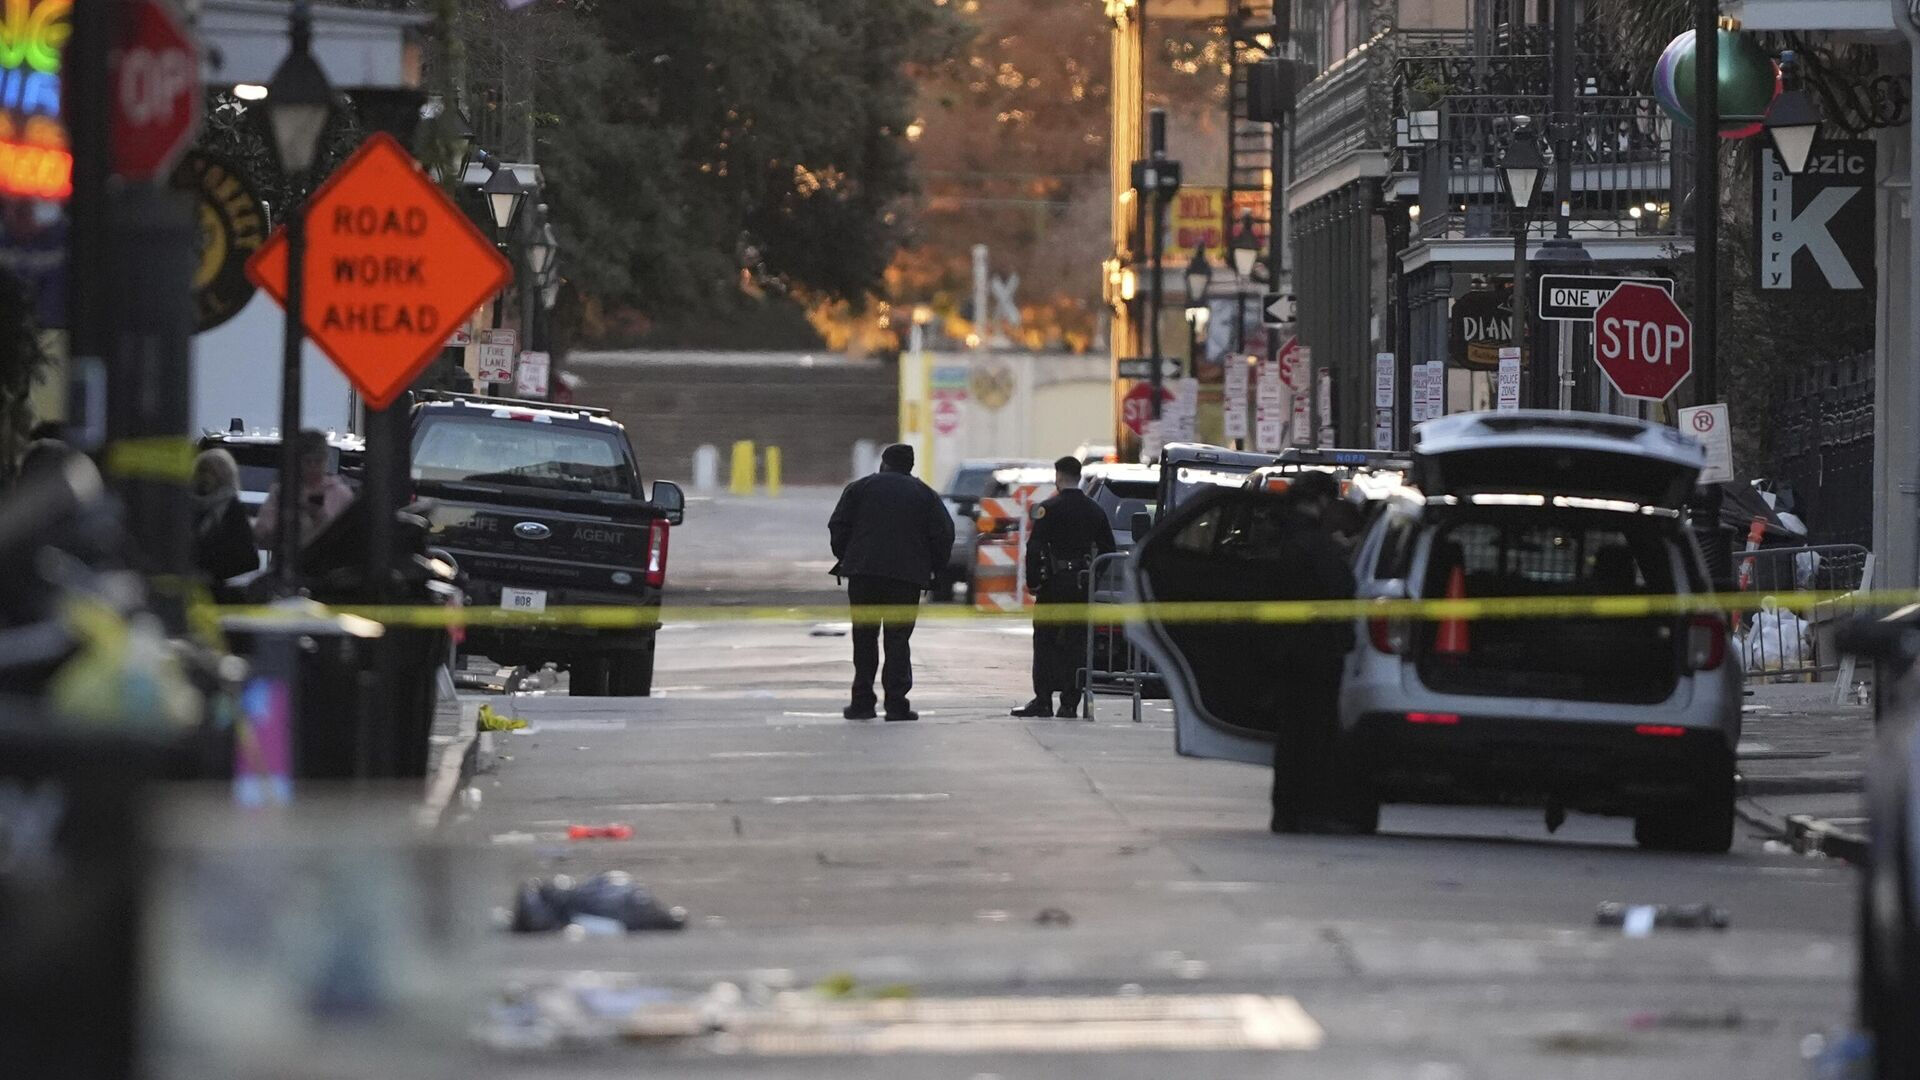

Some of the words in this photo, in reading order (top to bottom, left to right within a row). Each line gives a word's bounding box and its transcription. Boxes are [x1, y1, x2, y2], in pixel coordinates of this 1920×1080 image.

[333, 205, 428, 238] ROAD
[333, 255, 425, 287] WORK
[1555, 289, 1590, 306] ONE
[320, 303, 440, 336] AHEAD
[1463, 316, 1513, 341] DIAN
[1601, 317, 1685, 365] STOP
[485, 358, 506, 368] LANE
[1500, 374, 1518, 384] POLICE
[1501, 386, 1516, 396] ZONE
[1125, 398, 1151, 422] ST
[573, 528, 625, 544] AGENT
